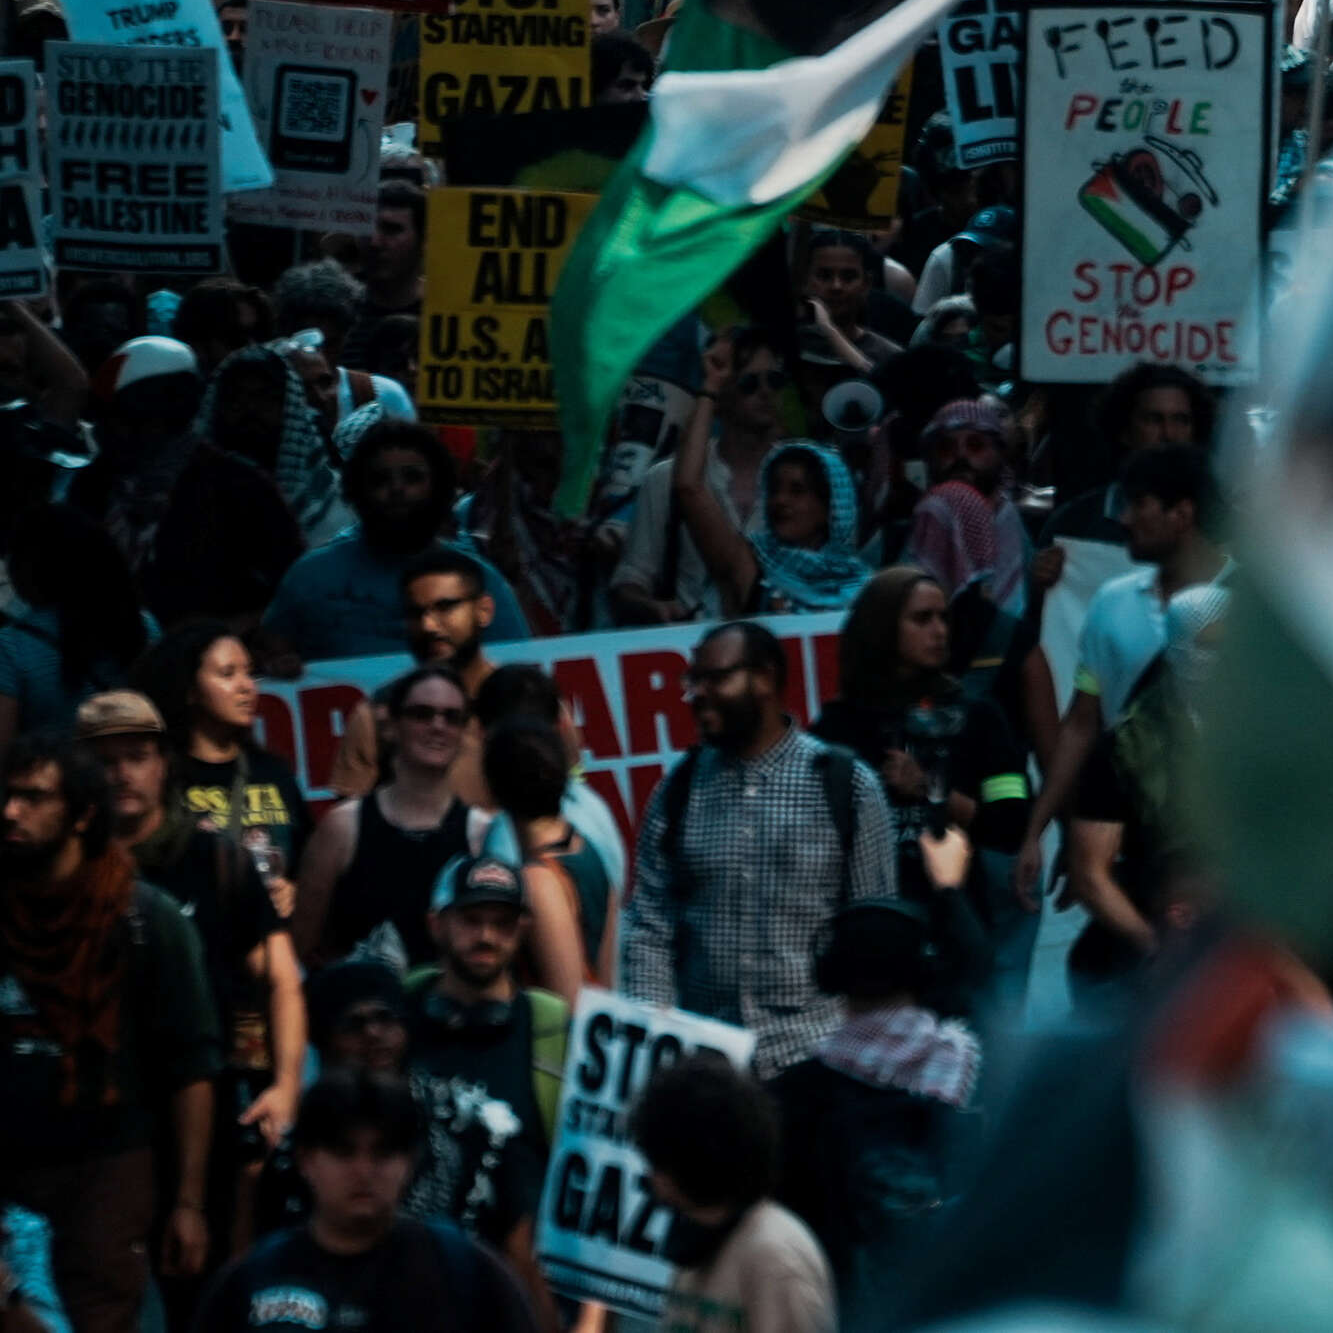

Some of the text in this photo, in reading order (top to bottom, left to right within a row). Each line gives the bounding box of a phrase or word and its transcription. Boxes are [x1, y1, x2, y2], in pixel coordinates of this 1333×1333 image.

[423, 16, 585, 48] STARVING
[1046, 15, 1240, 78] FEED
[60, 53, 206, 86] STOP THE
[59, 80, 207, 119] GENOCIDE
[1065, 94, 1211, 136] PEOPLE
[60, 161, 208, 197] FREE
[60, 196, 208, 235] PALESTINE
[469, 196, 566, 249] END
[472, 252, 550, 304] ALL
[1074, 261, 1196, 305] STOP
[430, 316, 509, 360] U.S.
[1045, 311, 1238, 363] GENOCIDE
[428, 368, 465, 400] TO
